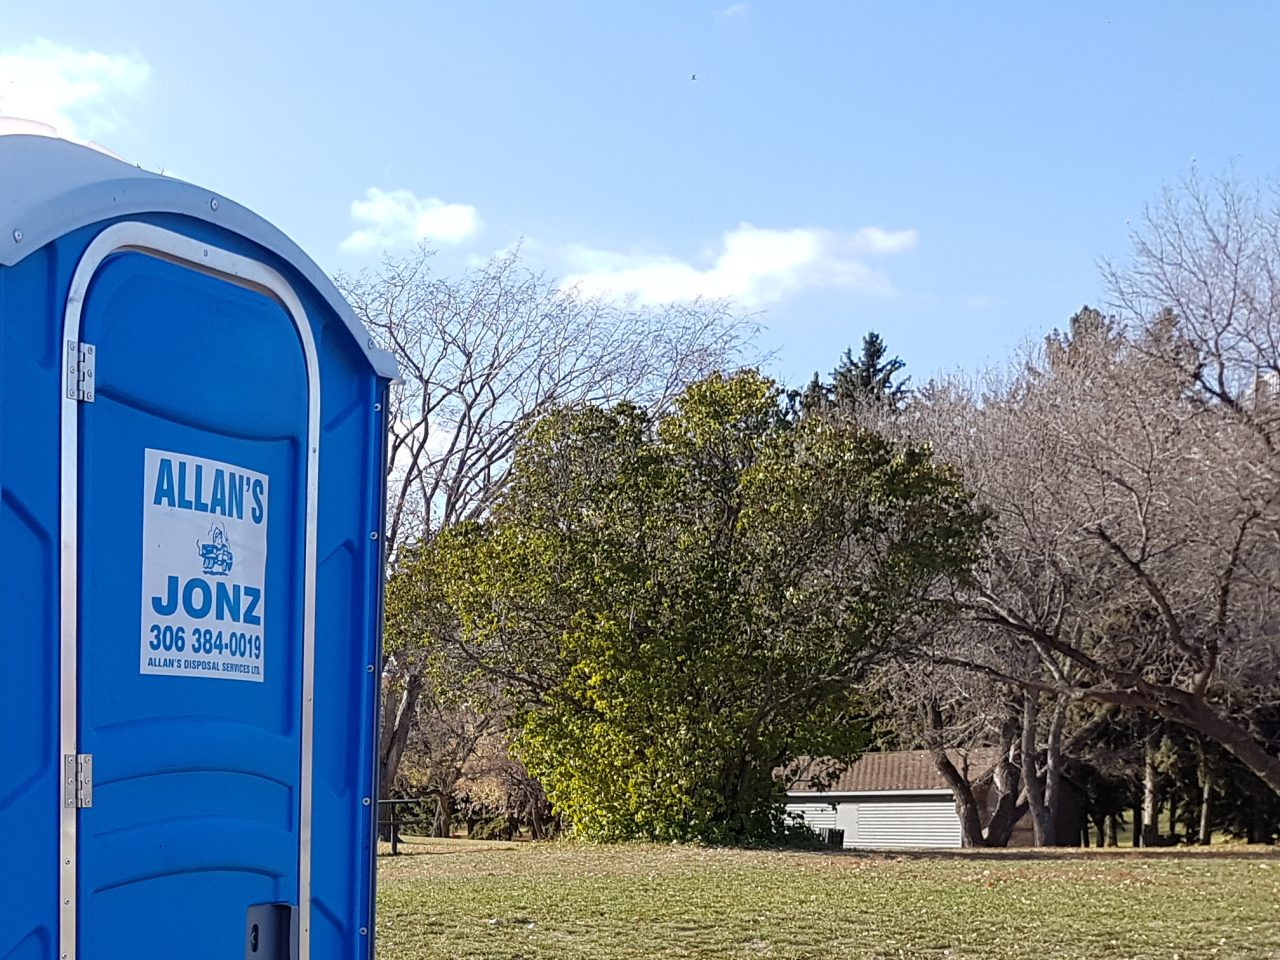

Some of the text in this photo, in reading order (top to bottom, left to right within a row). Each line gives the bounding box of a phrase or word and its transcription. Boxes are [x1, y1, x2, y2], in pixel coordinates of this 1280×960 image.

[153, 458, 264, 525] ALLAN'S
[151, 575, 261, 626] JONZ
[149, 624, 261, 660] 306 384-0019
[148, 658, 182, 668] ALLAN'S
[184, 660, 220, 671] DISPOSAL
[222, 663, 250, 674] SERVICES
